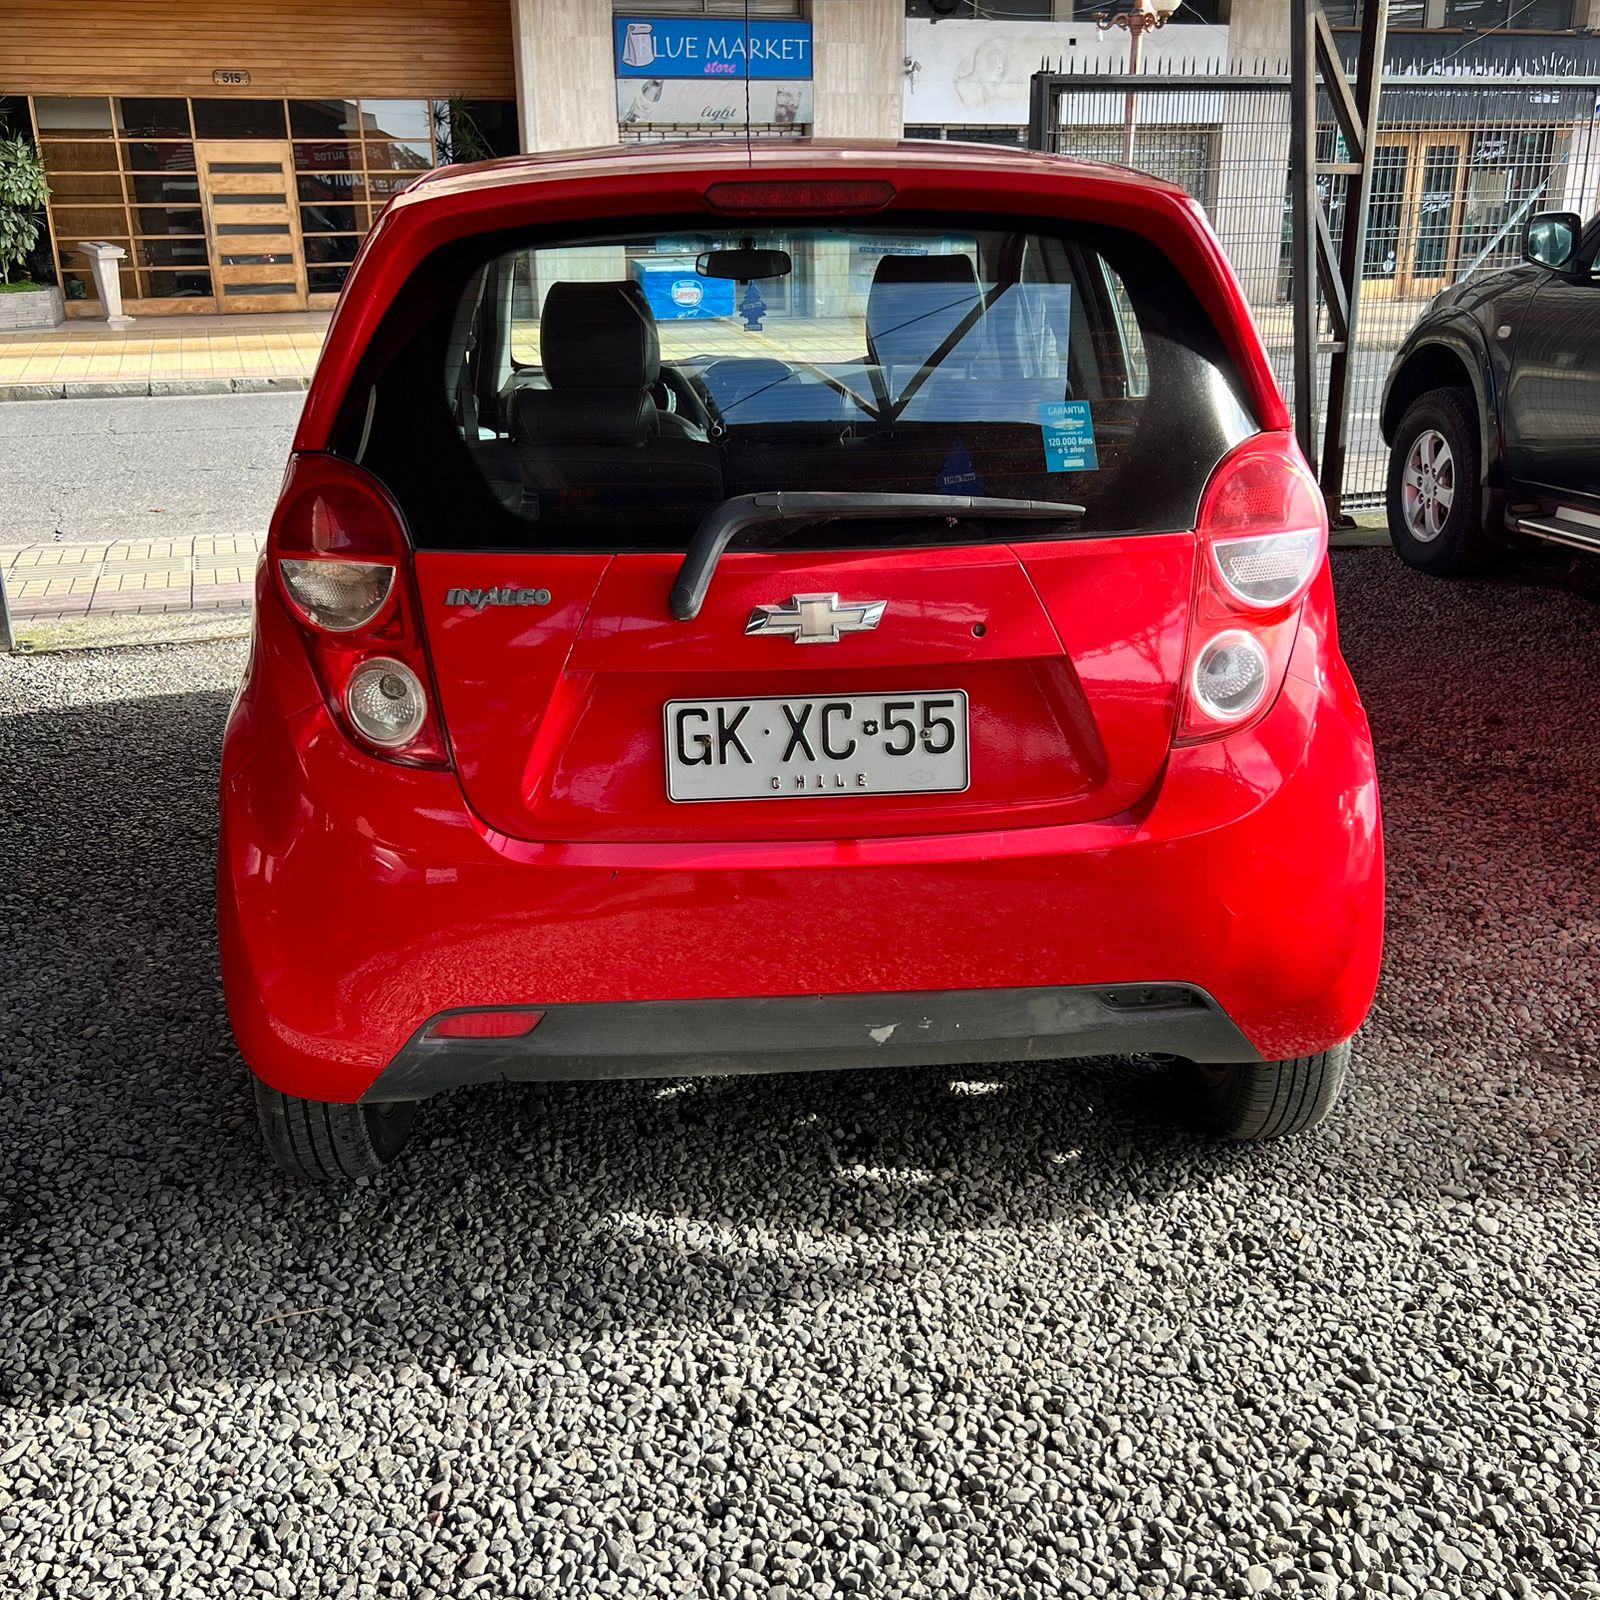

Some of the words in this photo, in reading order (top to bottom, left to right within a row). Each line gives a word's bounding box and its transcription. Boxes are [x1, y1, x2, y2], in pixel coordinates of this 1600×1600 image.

[706, 37, 809, 60] MARKET
[704, 61, 736, 74] store
[222, 72, 241, 83] 515
[701, 106, 737, 121] light
[1047, 406, 1086, 416] GARANTIA
[1048, 437, 1076, 446] 120.000
[1078, 437, 1093, 445] Kms
[445, 587, 551, 611] INALCO
[676, 705, 754, 766] GK
[781, 702, 857, 762] XC
[884, 699, 956, 756] 55
[771, 773, 868, 790] CHILE
